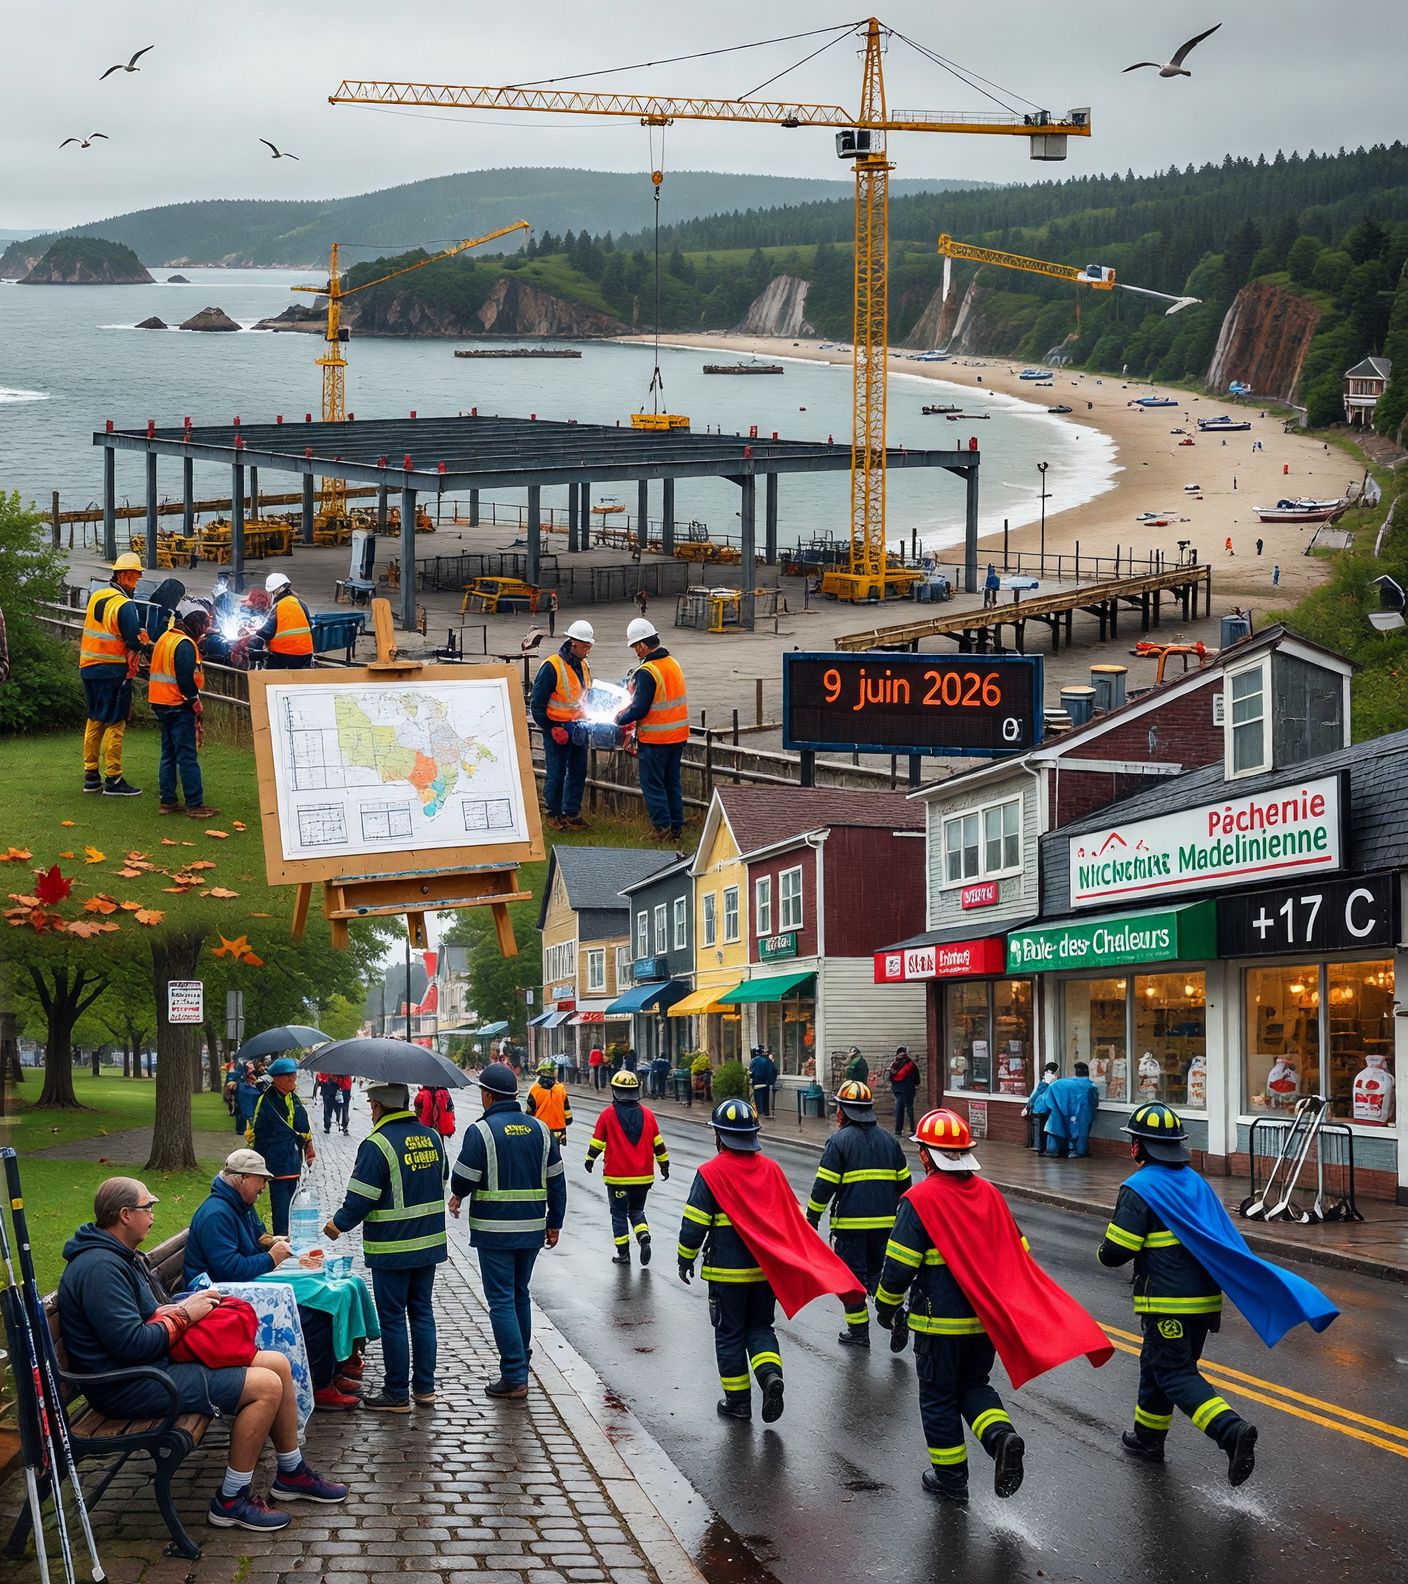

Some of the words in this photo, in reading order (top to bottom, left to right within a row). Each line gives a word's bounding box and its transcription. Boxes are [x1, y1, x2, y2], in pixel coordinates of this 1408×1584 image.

[822, 668, 842, 703] 9
[852, 668, 911, 712] juin
[922, 670, 1002, 707] 2026
[1178, 826, 1328, 874] Madelinienne
[1252, 894, 1324, 943] +17
[1344, 887, 1377, 938] C
